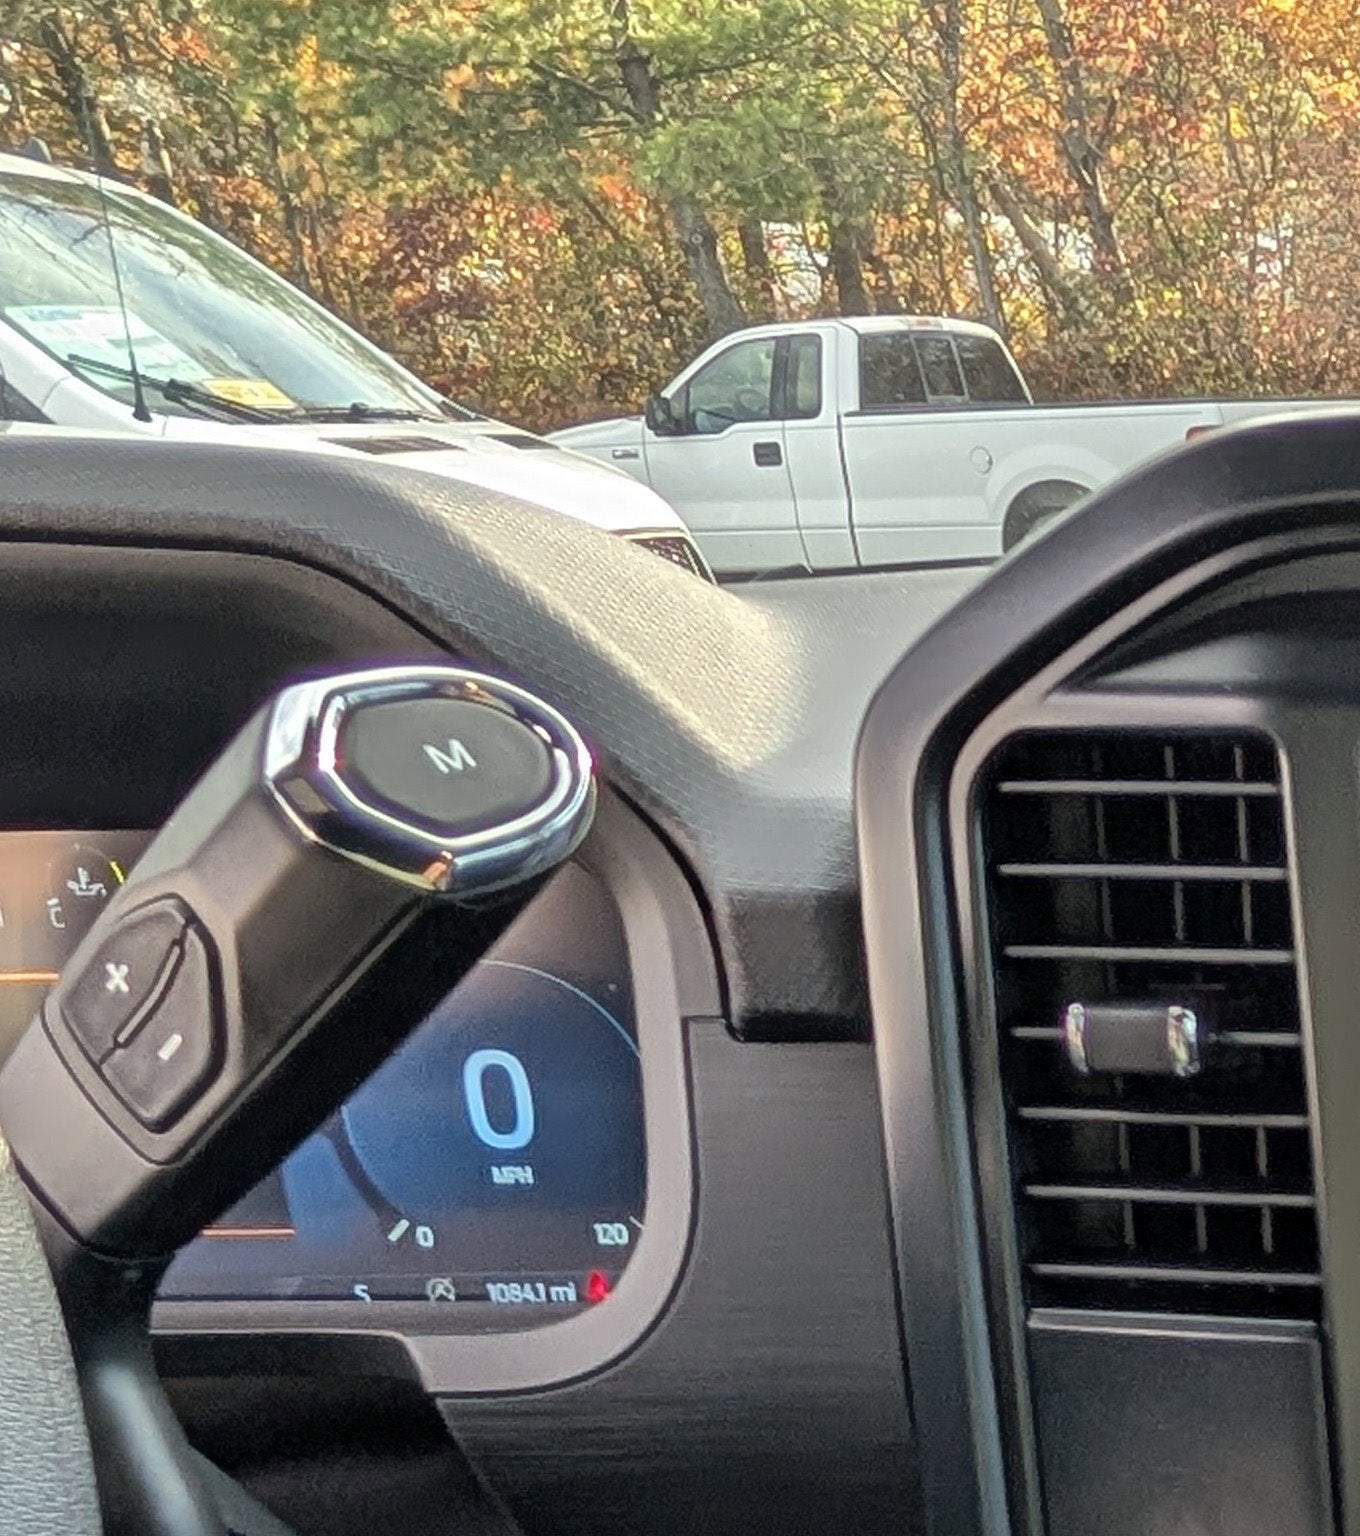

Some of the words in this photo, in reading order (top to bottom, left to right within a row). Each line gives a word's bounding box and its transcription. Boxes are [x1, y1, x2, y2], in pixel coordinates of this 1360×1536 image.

[423, 738, 477, 776] M
[462, 1048, 535, 1151] 0
[490, 1165, 534, 1184] MPH
[415, 1225, 434, 1248] 0
[593, 1222, 630, 1246] 120
[550, 1280, 578, 1302] mi
